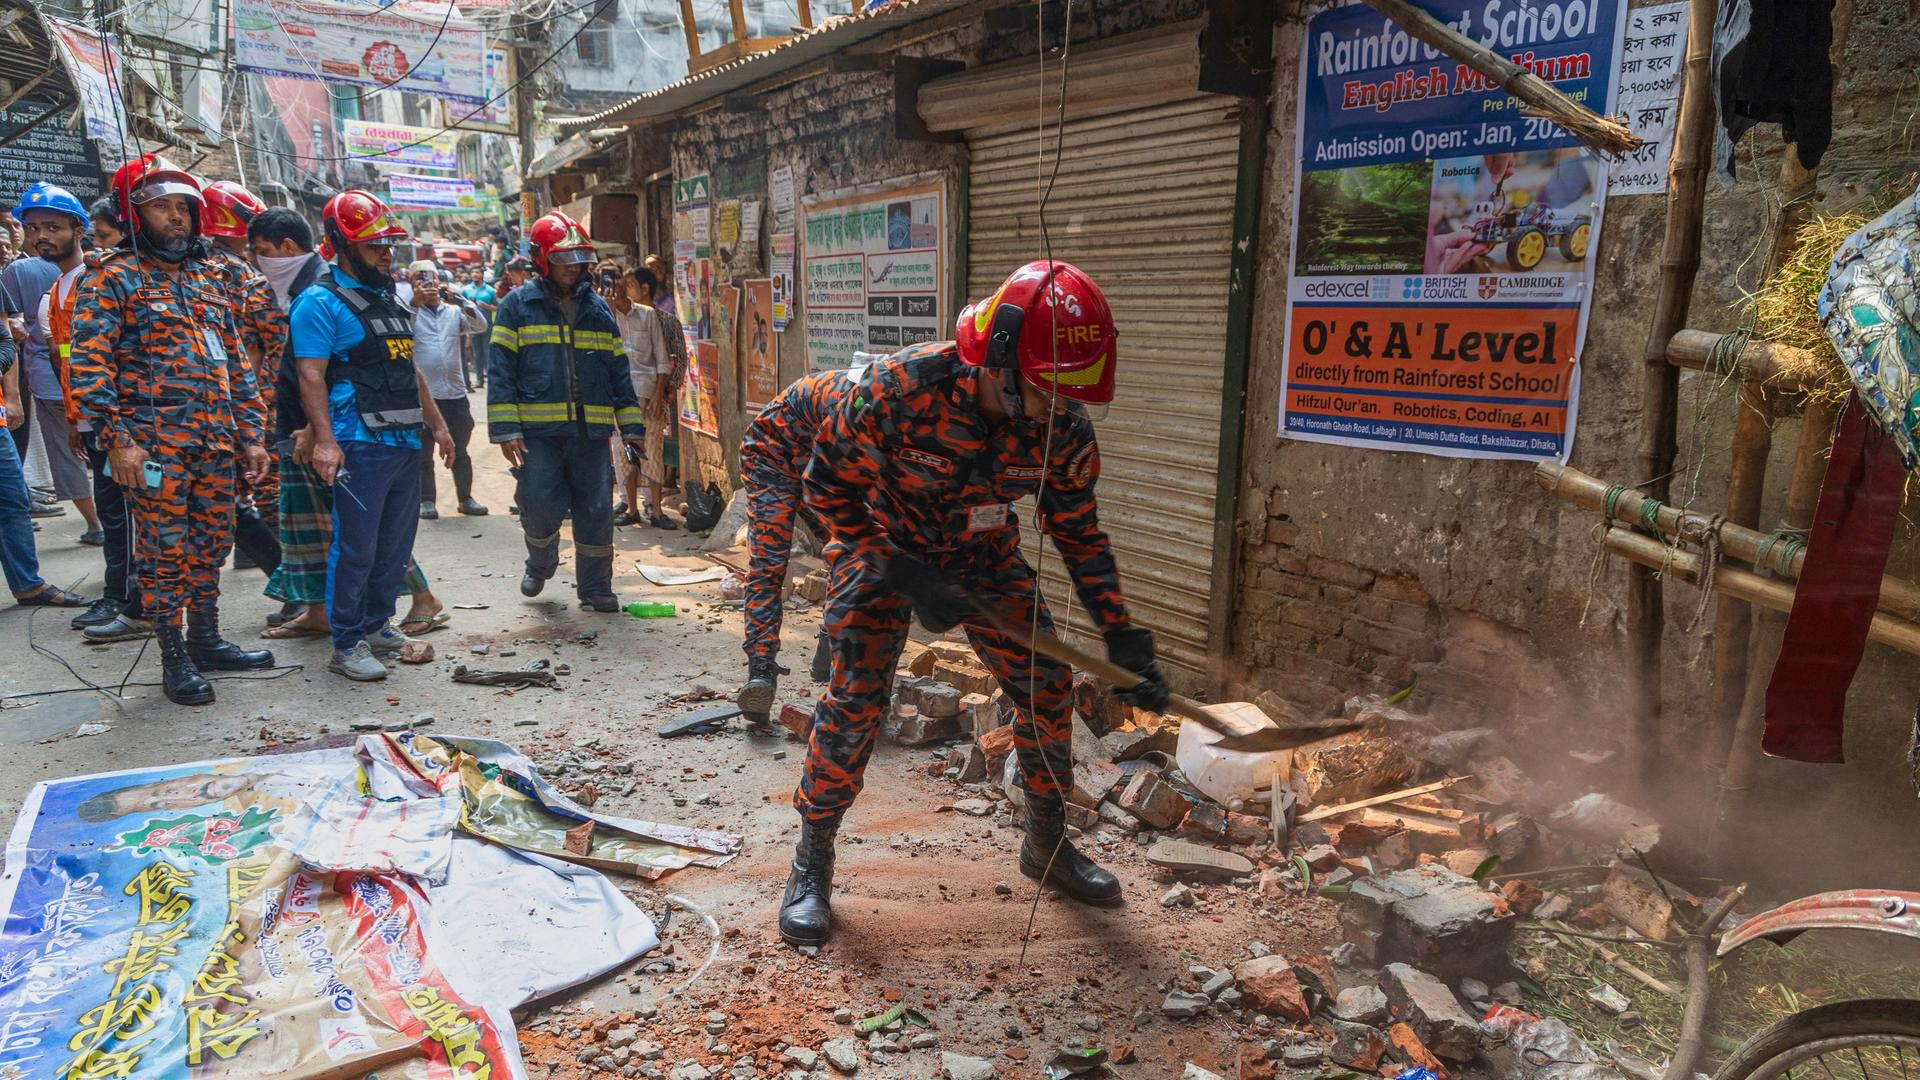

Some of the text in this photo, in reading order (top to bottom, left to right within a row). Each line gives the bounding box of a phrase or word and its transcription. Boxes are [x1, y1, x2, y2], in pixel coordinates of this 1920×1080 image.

[1633, 11, 1683, 31] ২ রুম
[1317, 0, 1600, 77] Rainfort School
[1650, 32, 1678, 49] করা
[1646, 55, 1674, 71] হবে
[1342, 51, 1591, 112] English Mium
[1482, 99, 1504, 113] Pre
[1506, 96, 1531, 112] Pla
[1638, 107, 1669, 129] রুম
[1315, 133, 1407, 162] Admission
[1411, 127, 1468, 158] Open:
[1473, 122, 1517, 147] Jan,
[1441, 164, 1481, 178] Robotics
[1355, 262, 1382, 271] towards
[1305, 276, 1565, 298] edexcel BRITISH CAMBRIDGE
[1423, 288, 1468, 299] COUNCIL
[1055, 324, 1102, 345] FIRE
[1303, 320, 1557, 365] O' & A' Level
[1295, 361, 1560, 393] directly from Rainforest School
[1296, 394, 1331, 410] Hifzul
[1393, 401, 1461, 423] Robotics,
[1464, 406, 1526, 428] Coding,
[1530, 411, 1550, 427] AI
[1332, 421, 1353, 432] Ghosh
[1353, 422, 1371, 435] Road,
[1371, 424, 1397, 439] Lalbagh
[1404, 427, 1415, 439] 20,
[1415, 428, 1439, 440] Umesh
[1440, 430, 1459, 442] Dutta
[1459, 432, 1480, 445] Road,
[1481, 434, 1530, 449] Bakshibazar,
[1530, 438, 1557, 450] Dhaka
[289, 874, 313, 908] নগদ
